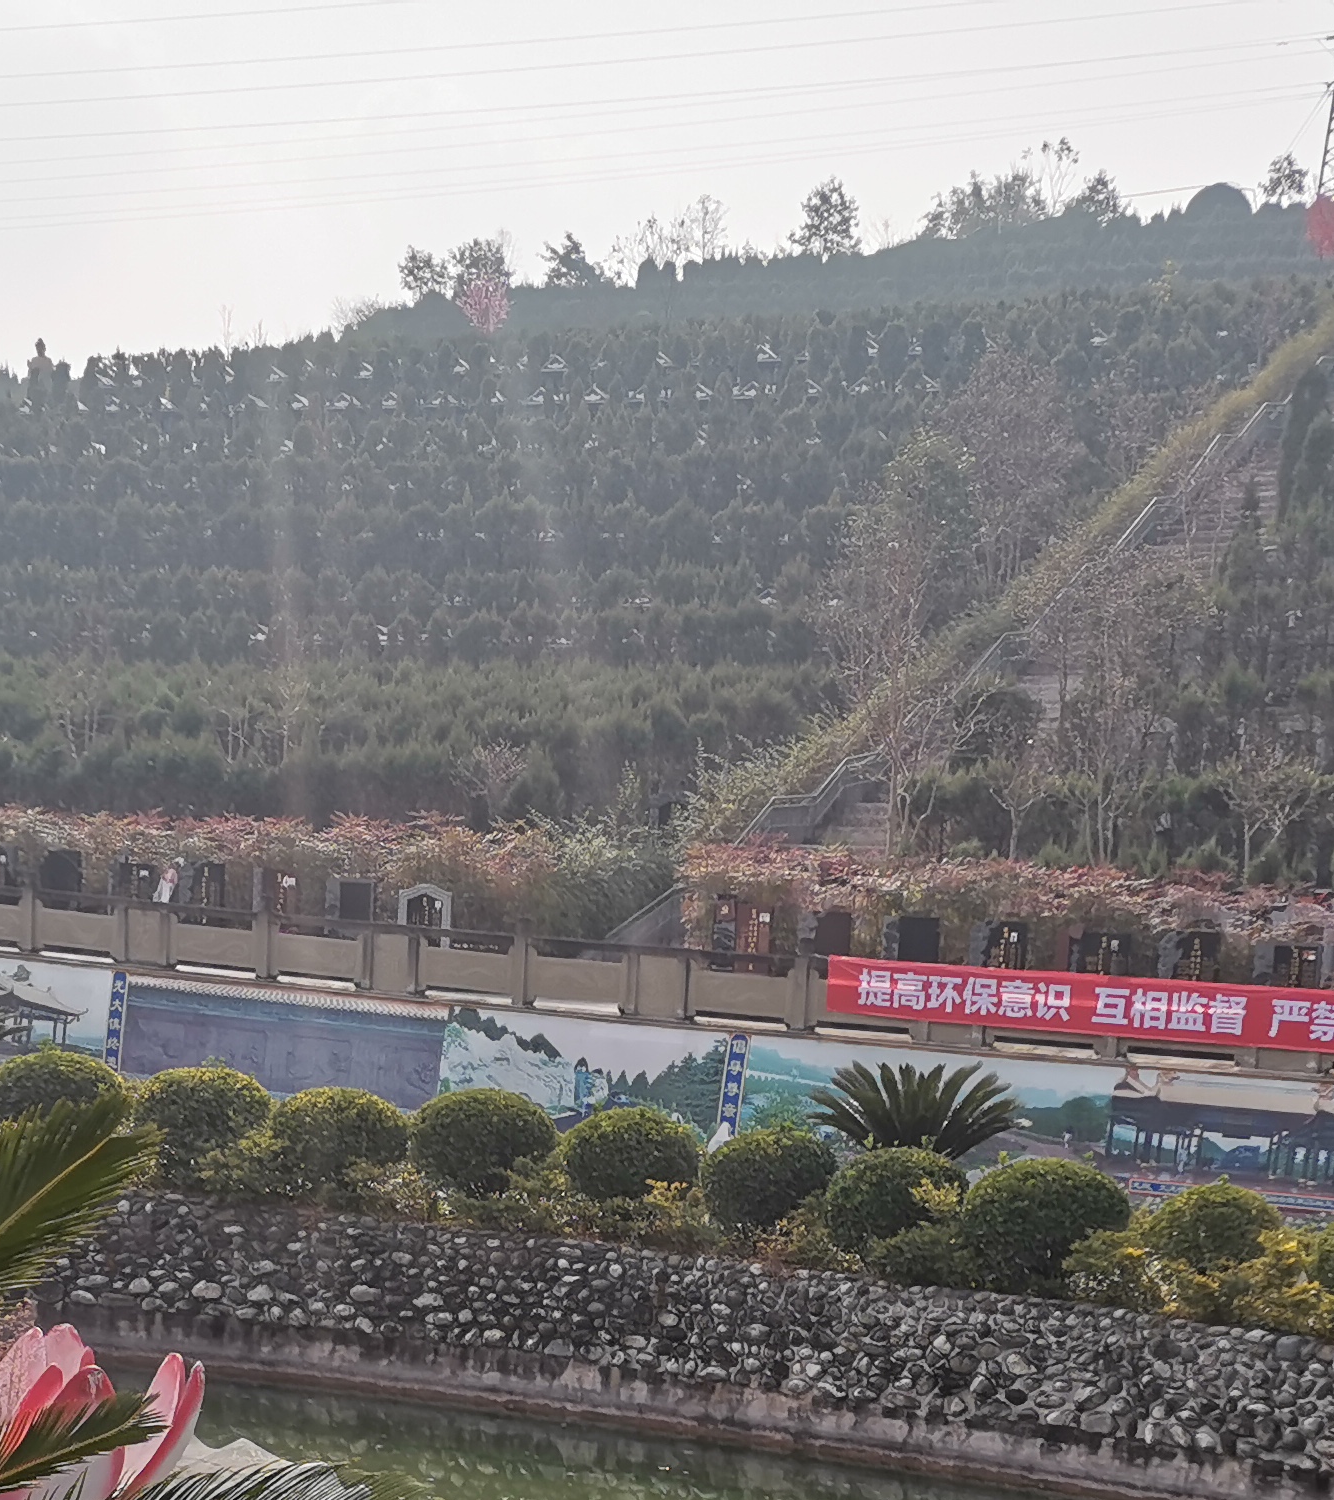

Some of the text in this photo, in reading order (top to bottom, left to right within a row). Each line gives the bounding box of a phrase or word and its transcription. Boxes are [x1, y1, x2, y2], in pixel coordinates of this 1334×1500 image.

[858, 968, 1073, 1022] 提高环保意识
[1091, 983, 1248, 1037] 互相监督
